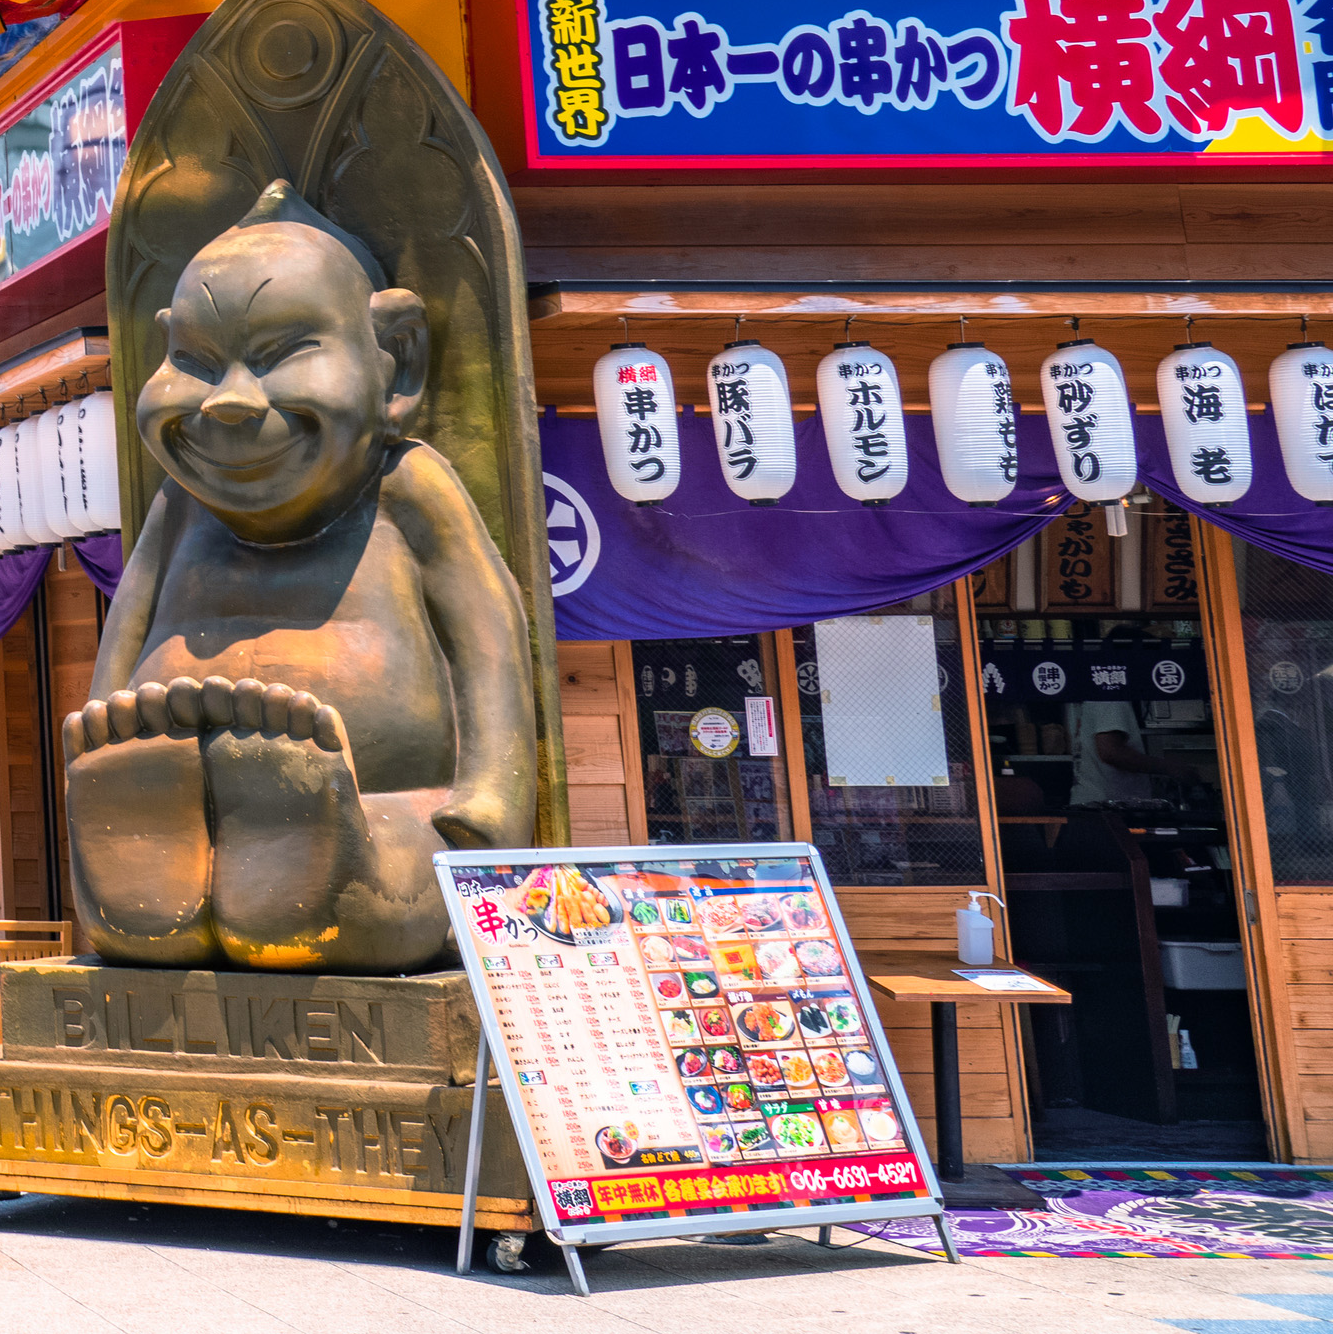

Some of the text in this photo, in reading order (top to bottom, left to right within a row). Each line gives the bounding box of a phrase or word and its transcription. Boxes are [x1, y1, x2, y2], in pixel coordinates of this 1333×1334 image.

[613, 15, 1001, 111] 日本一の串かつ
[617, 364, 661, 385] 横綱
[711, 362, 750, 380] 串かつ
[838, 363, 883, 378] 串かつ
[1050, 362, 1094, 379] 串かつ
[1175, 364, 1222, 381] 串かつ
[623, 387, 666, 485] 串かつ
[716, 380, 759, 481] 豚バラ
[848, 380, 892, 485] ホルモン
[1056, 379, 1101, 484] 砂ずり
[1183, 383, 1233, 485] 海老
[458, 881, 505, 899] 日本一の
[471, 895, 539, 943] 串かつ
[53, 986, 387, 1065] BILLIKEN
[764, 1103, 789, 1115] サラダ
[598, 1162, 918, 1206] 年中無休 各種宴会承ります! 06-6631-4527
